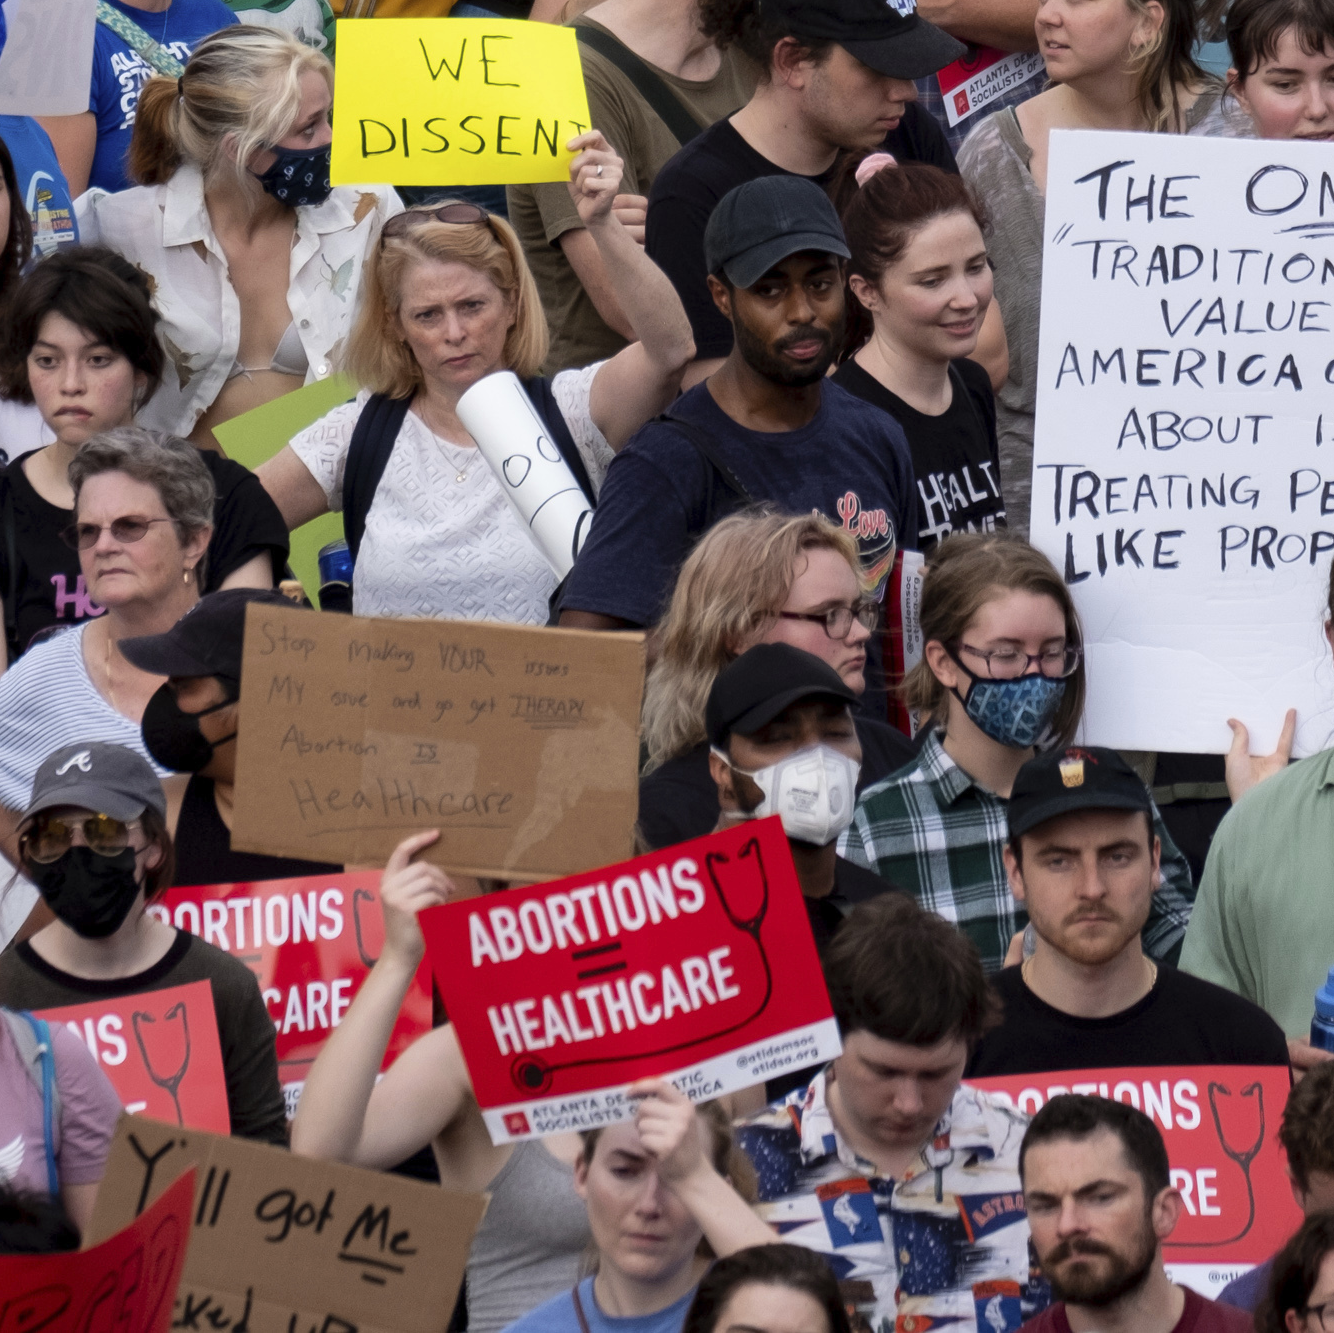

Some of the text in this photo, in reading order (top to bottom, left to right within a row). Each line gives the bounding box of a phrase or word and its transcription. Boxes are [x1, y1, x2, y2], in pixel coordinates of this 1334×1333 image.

[418, 34, 521, 90] WE
[969, 64, 1010, 96] ATLANTA
[1074, 160, 1201, 223] THE
[1055, 343, 1302, 392] AMERICA
[1117, 407, 1273, 451] ABOUT
[836, 491, 890, 541] Love
[1036, 464, 1259, 527] TREATING
[1063, 529, 1182, 587] LIKE
[260, 623, 317, 658] Stop
[280, 724, 379, 757] Abortion
[288, 777, 515, 821] Healthcare
[469, 857, 705, 968] ABORTIONS
[487, 945, 741, 1057] HEALTHCARE
[254, 1188, 418, 1256] got Me
[972, 1194, 1025, 1227] ASTRO
